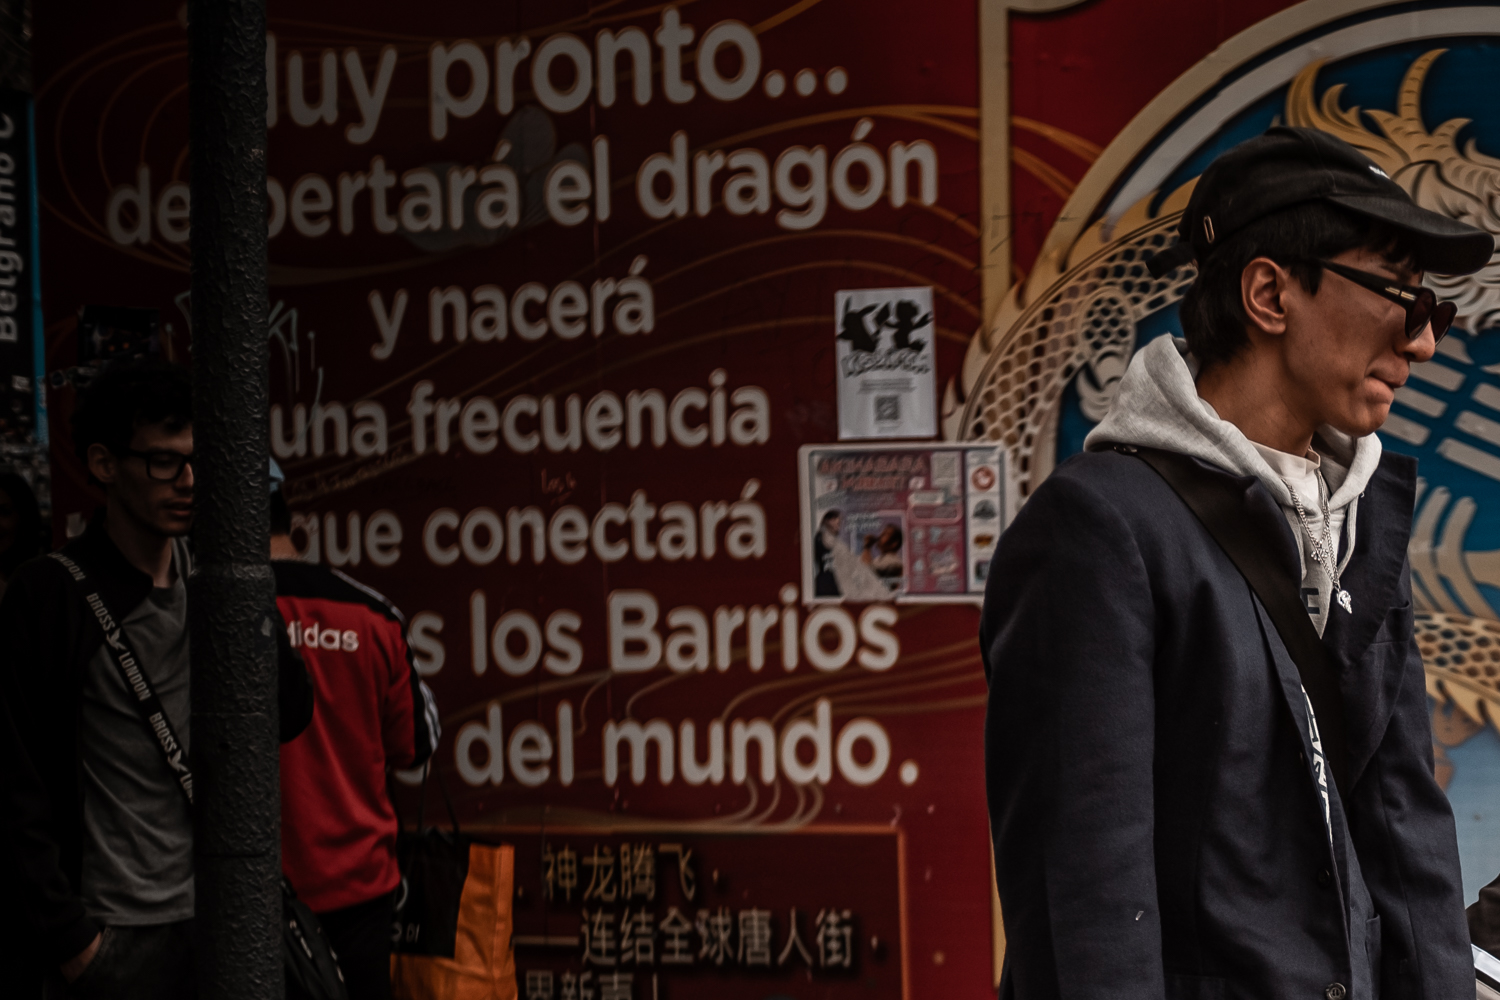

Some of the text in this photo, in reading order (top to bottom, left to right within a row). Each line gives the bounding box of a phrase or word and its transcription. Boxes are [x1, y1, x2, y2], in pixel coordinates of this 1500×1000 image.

[267, 8, 848, 145] uy pronto...
[107, 118, 938, 246] deertará el dragón
[369, 290, 408, 361] y
[430, 255, 656, 344] nacerá
[270, 369, 771, 458] una frecuencia
[424, 478, 767, 566] conectará
[85, 592, 116, 632] BROSS
[117, 651, 152, 702] LONDON
[148, 711, 179, 753] BROSS
[471, 591, 584, 676] los
[608, 582, 902, 674] Barrios
[455, 698, 919, 787] del mundo.
